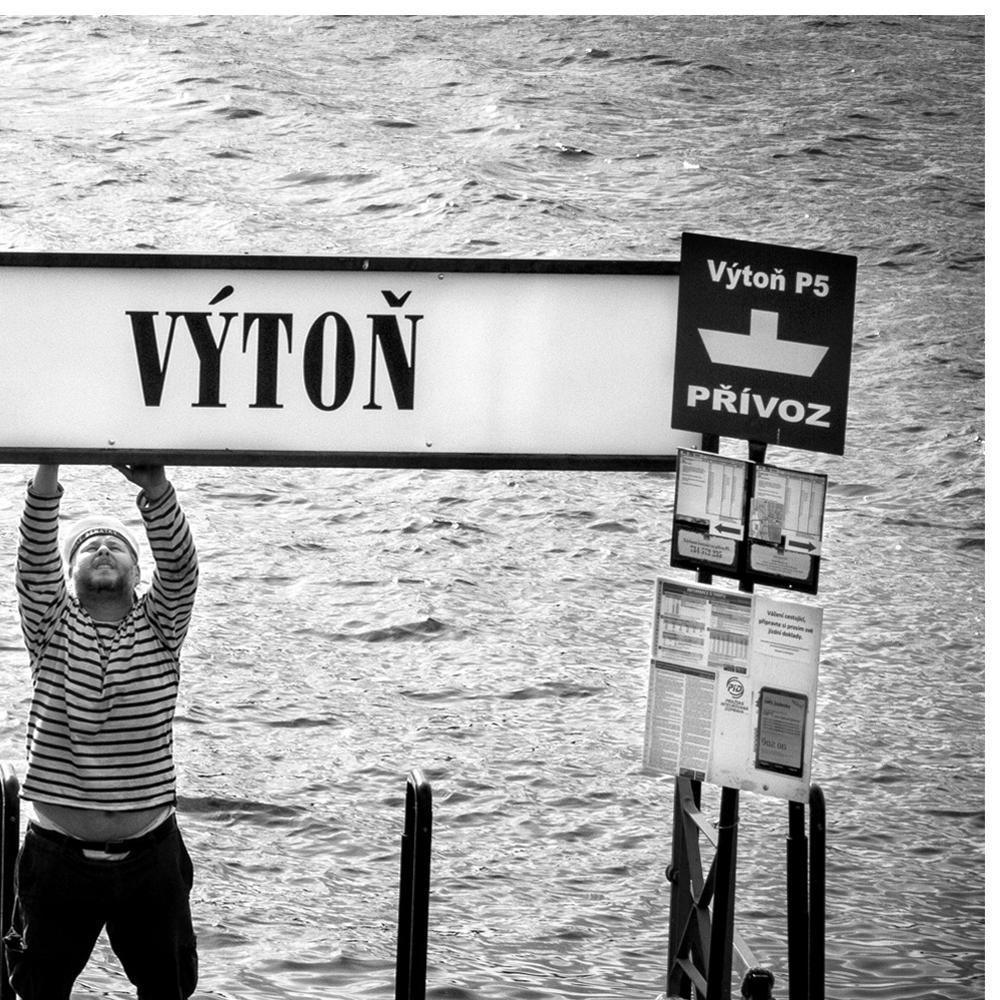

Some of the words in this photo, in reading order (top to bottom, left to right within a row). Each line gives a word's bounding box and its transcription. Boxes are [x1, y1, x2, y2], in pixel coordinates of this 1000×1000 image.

[707, 258, 786, 291] Výtoň
[795, 271, 830, 298] P5
[124, 285, 425, 412] VÝTOŇ
[686, 383, 832, 428] PŘÍVOZ
